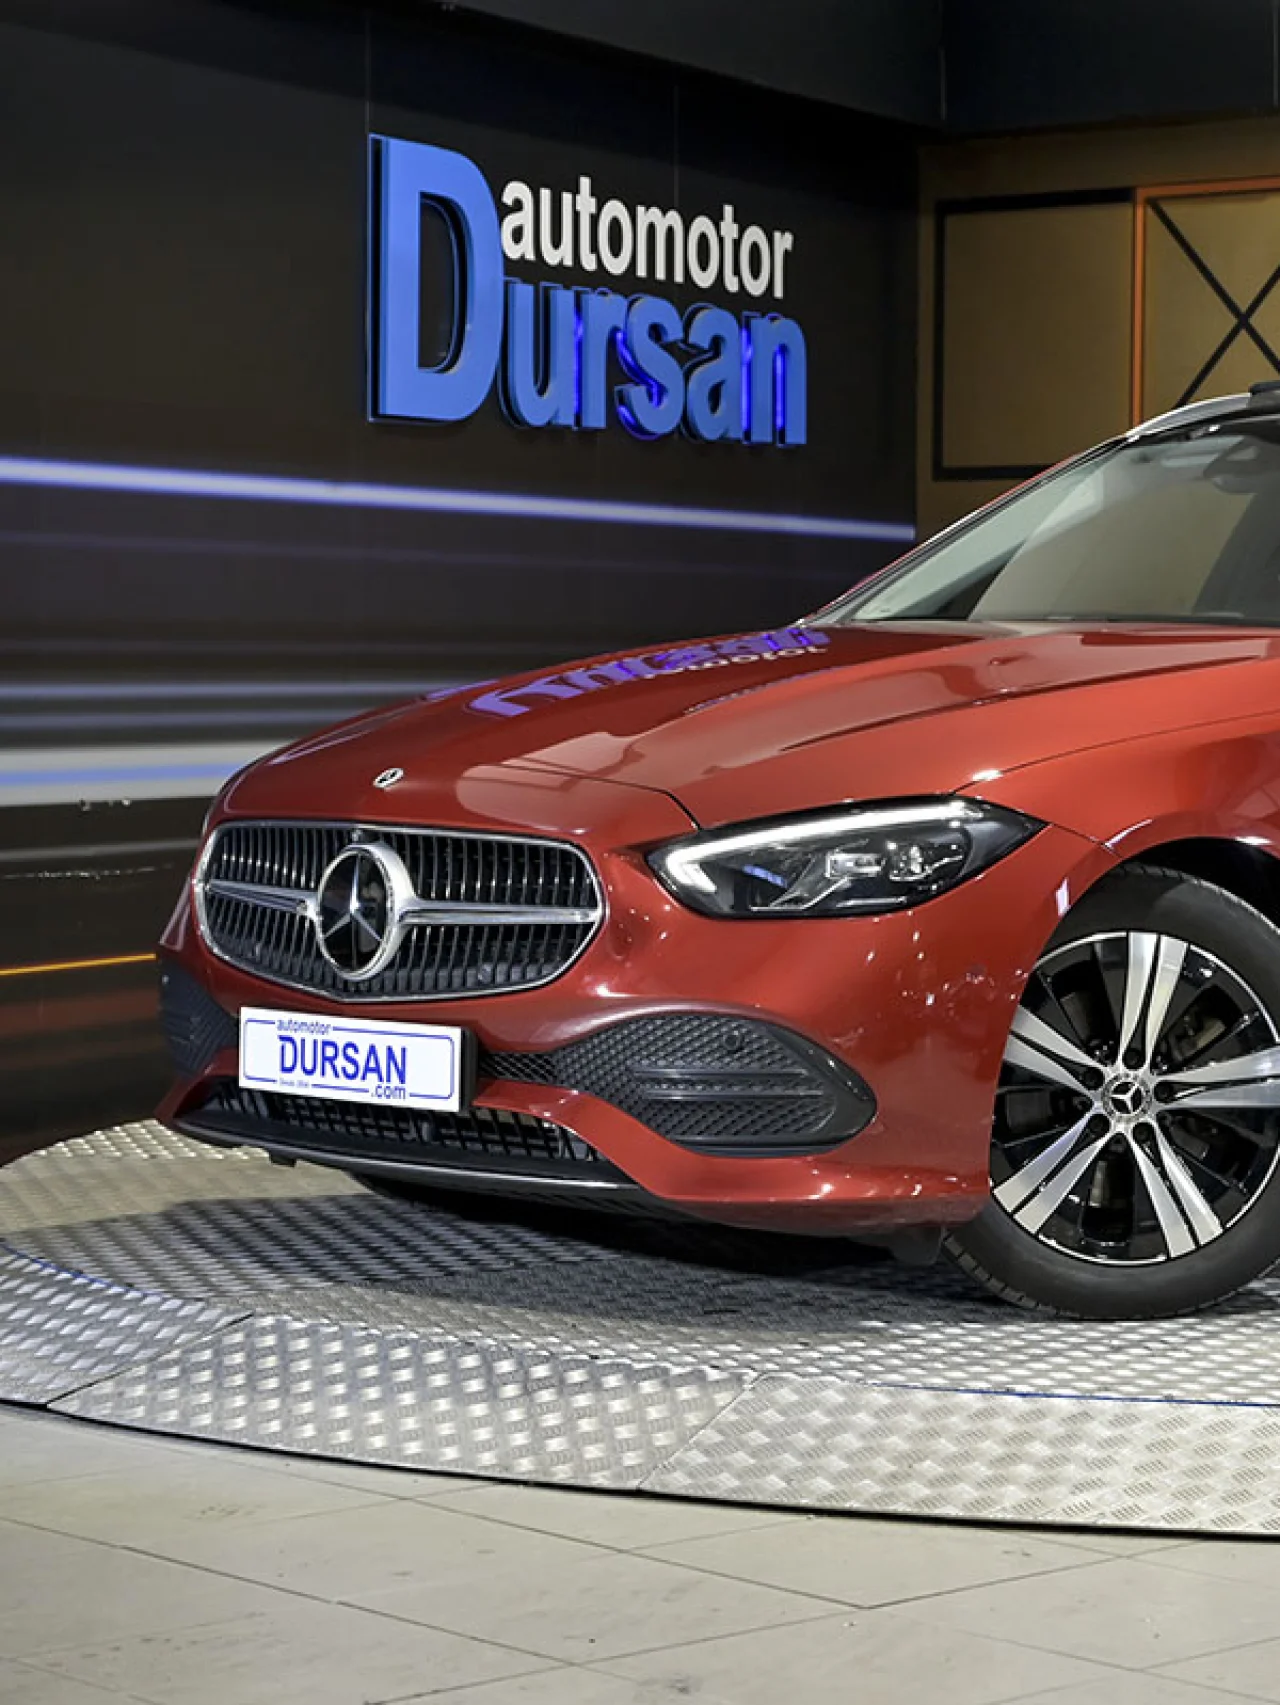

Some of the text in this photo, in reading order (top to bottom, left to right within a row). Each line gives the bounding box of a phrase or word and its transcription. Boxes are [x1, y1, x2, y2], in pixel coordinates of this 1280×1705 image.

[500, 175, 794, 299] automotor
[367, 133, 808, 447] Dursan
[277, 1018, 331, 1036] automotor
[278, 1035, 407, 1085] DURSAN
[371, 1084, 407, 1100] .com
